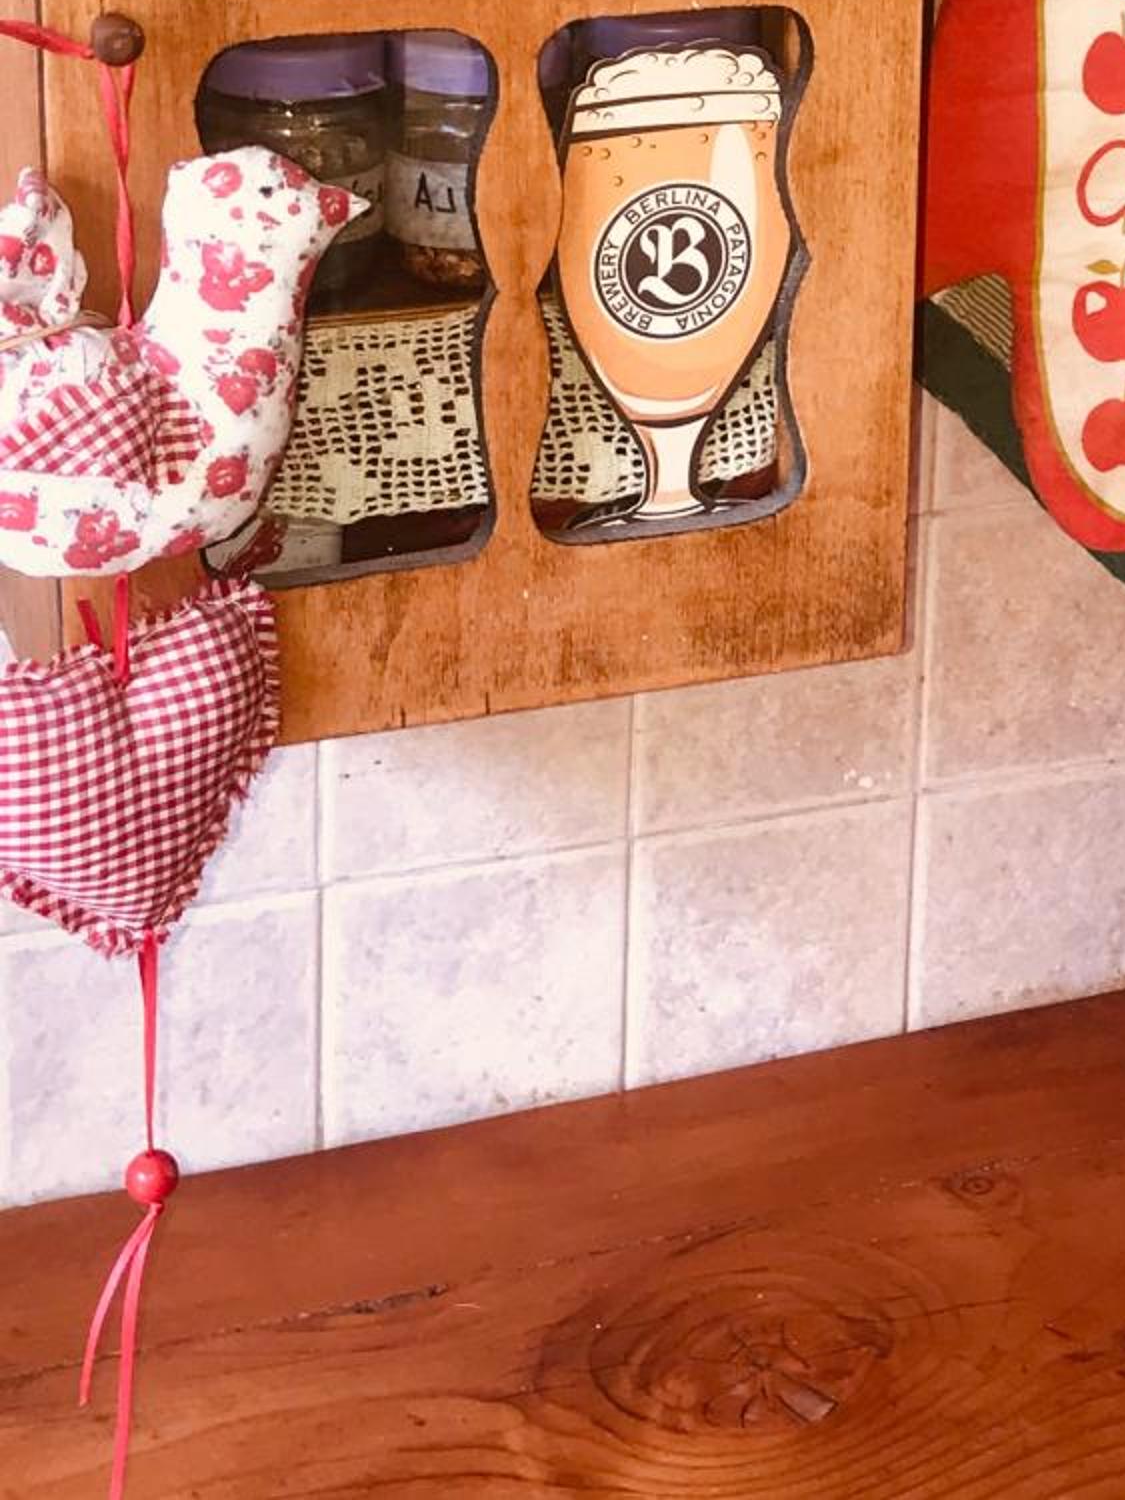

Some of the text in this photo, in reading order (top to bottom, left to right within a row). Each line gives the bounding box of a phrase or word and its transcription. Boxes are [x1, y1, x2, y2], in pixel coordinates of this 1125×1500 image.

[601, 189, 746, 331] BERLINA PATAGONIA BREWERY
